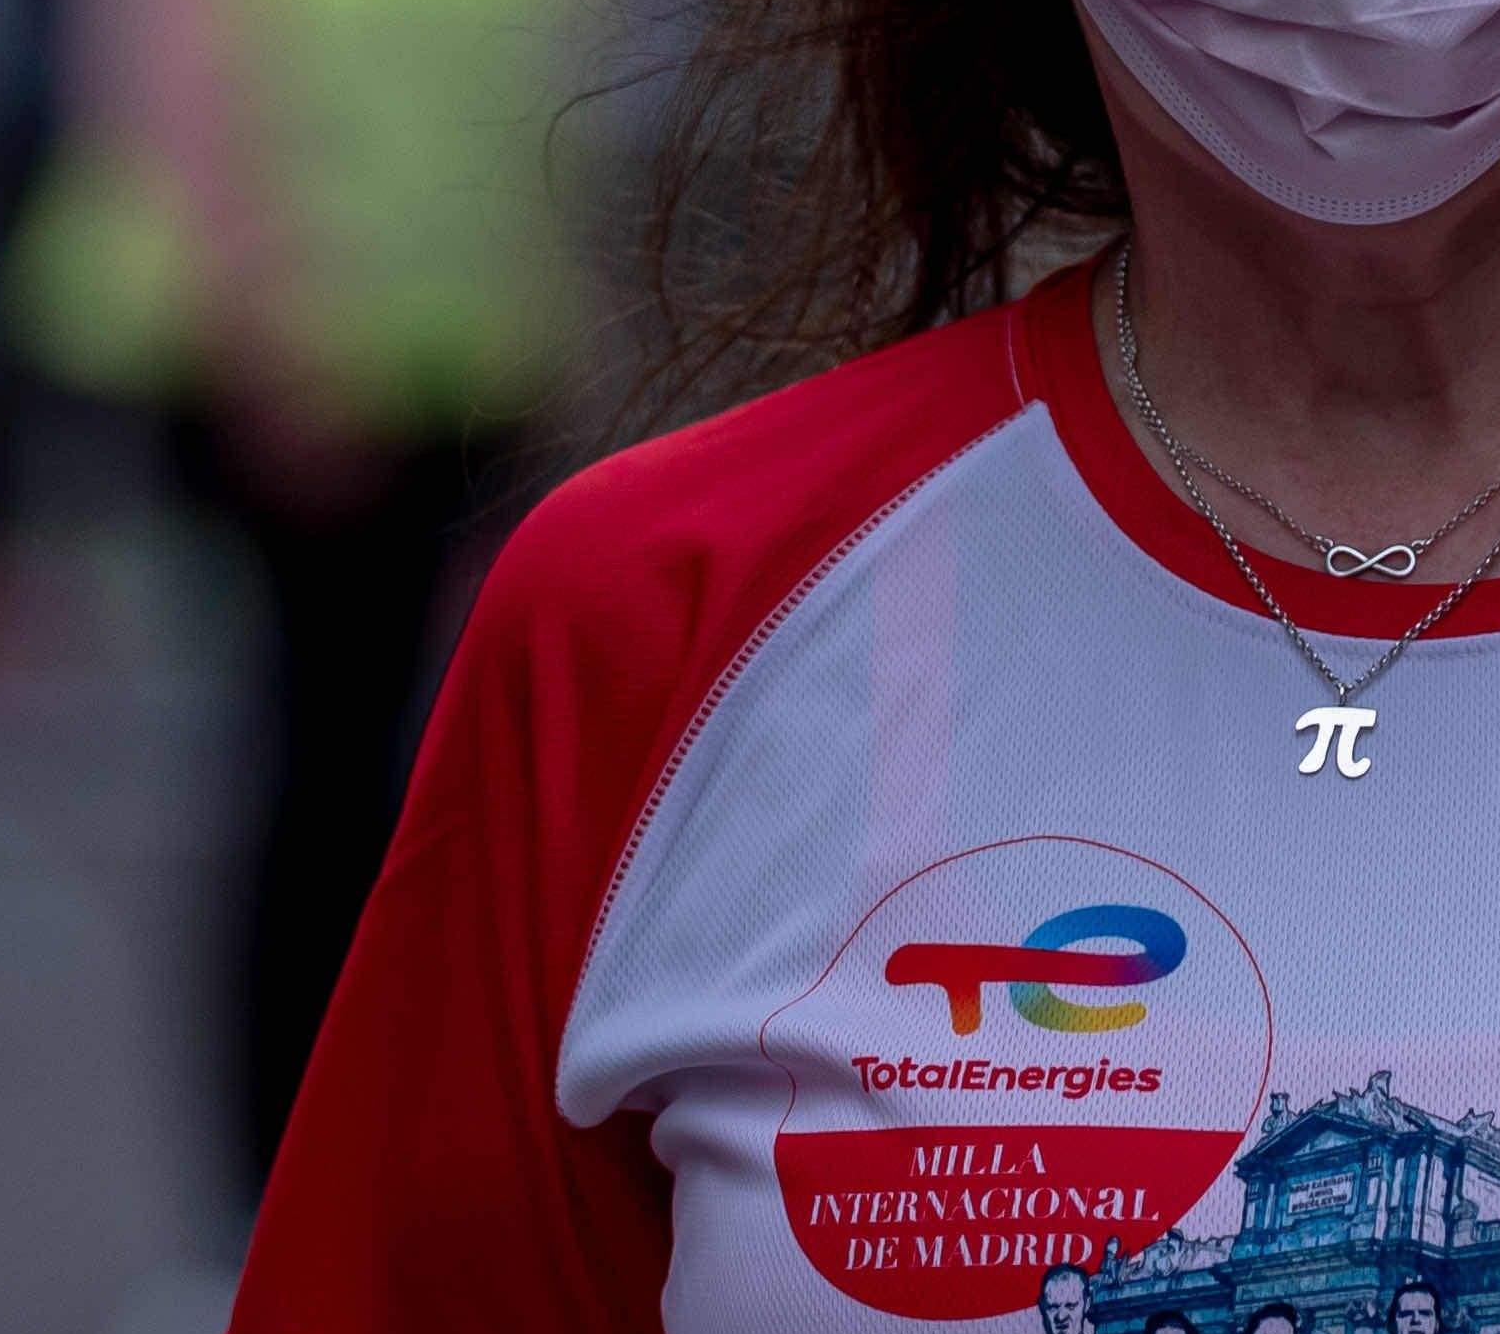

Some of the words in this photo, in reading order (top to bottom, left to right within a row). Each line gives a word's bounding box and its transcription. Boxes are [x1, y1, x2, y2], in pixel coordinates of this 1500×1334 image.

[851, 1054, 1163, 1100] TotalEnergies
[910, 1142, 1047, 1178] MILLA
[845, 1235, 900, 1271] DE
[912, 1231, 1094, 1270] MADRID
